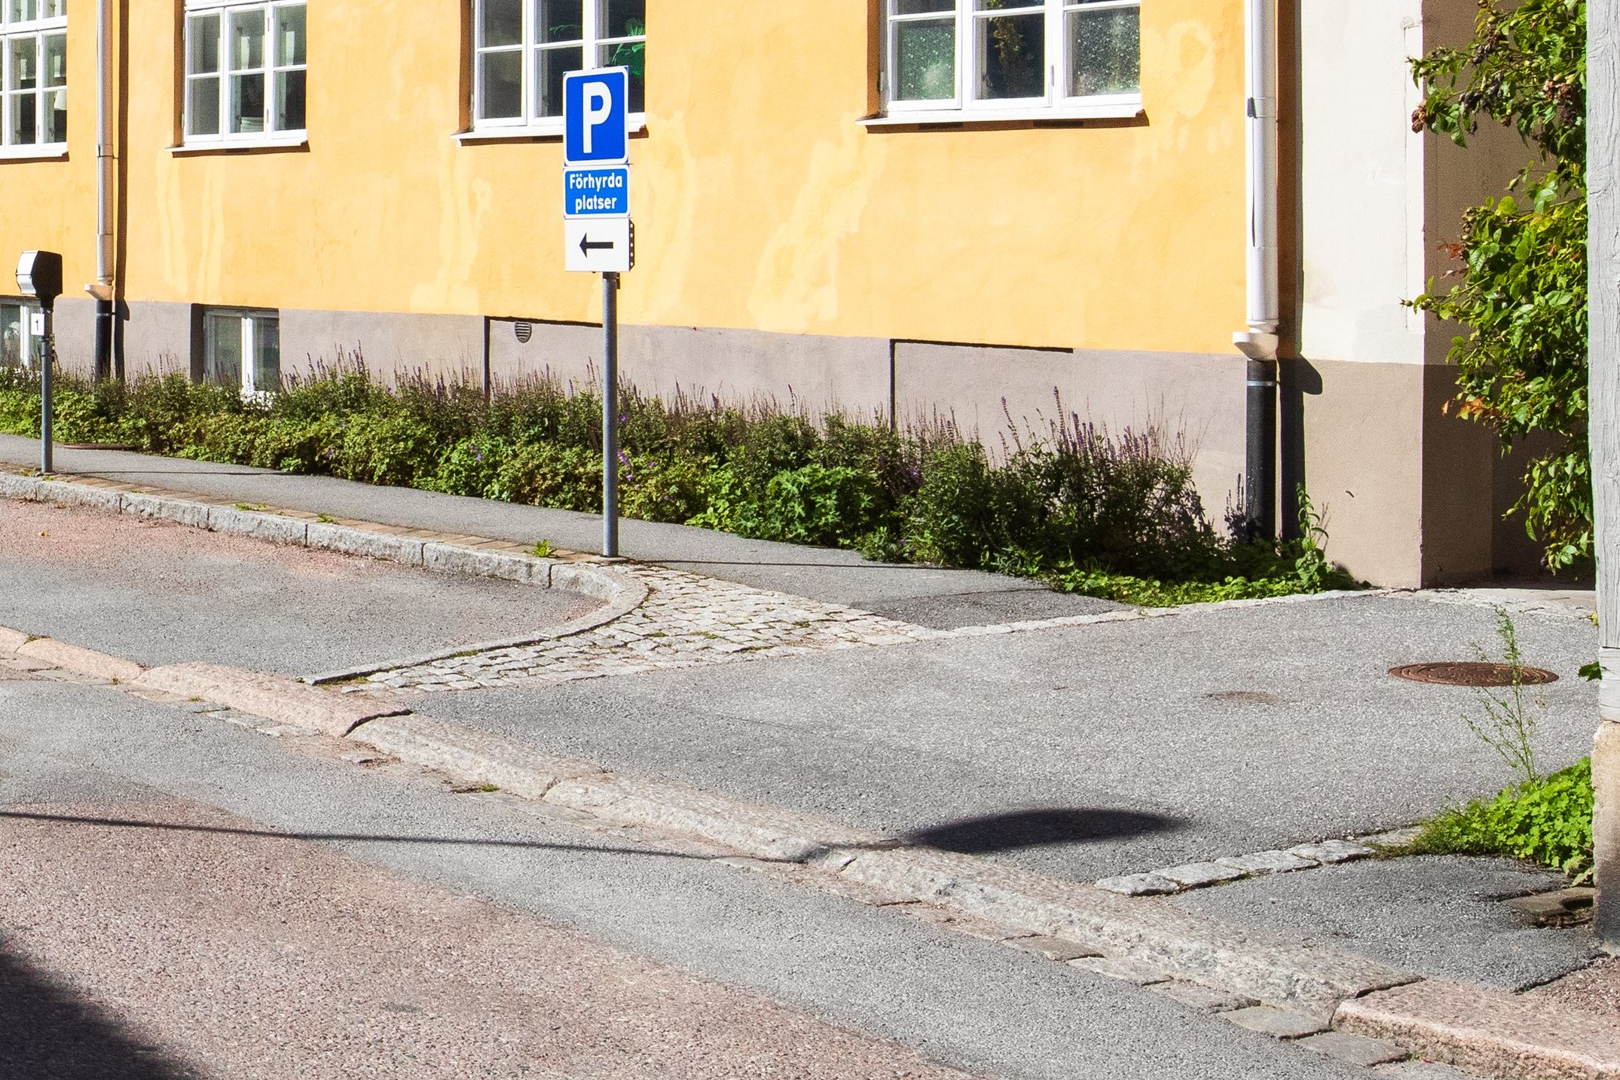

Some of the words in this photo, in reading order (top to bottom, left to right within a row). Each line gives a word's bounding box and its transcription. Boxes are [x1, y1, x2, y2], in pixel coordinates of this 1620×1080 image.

[582, 80, 613, 154] P
[569, 172, 623, 192] Förhyrda
[575, 194, 618, 214] platser
